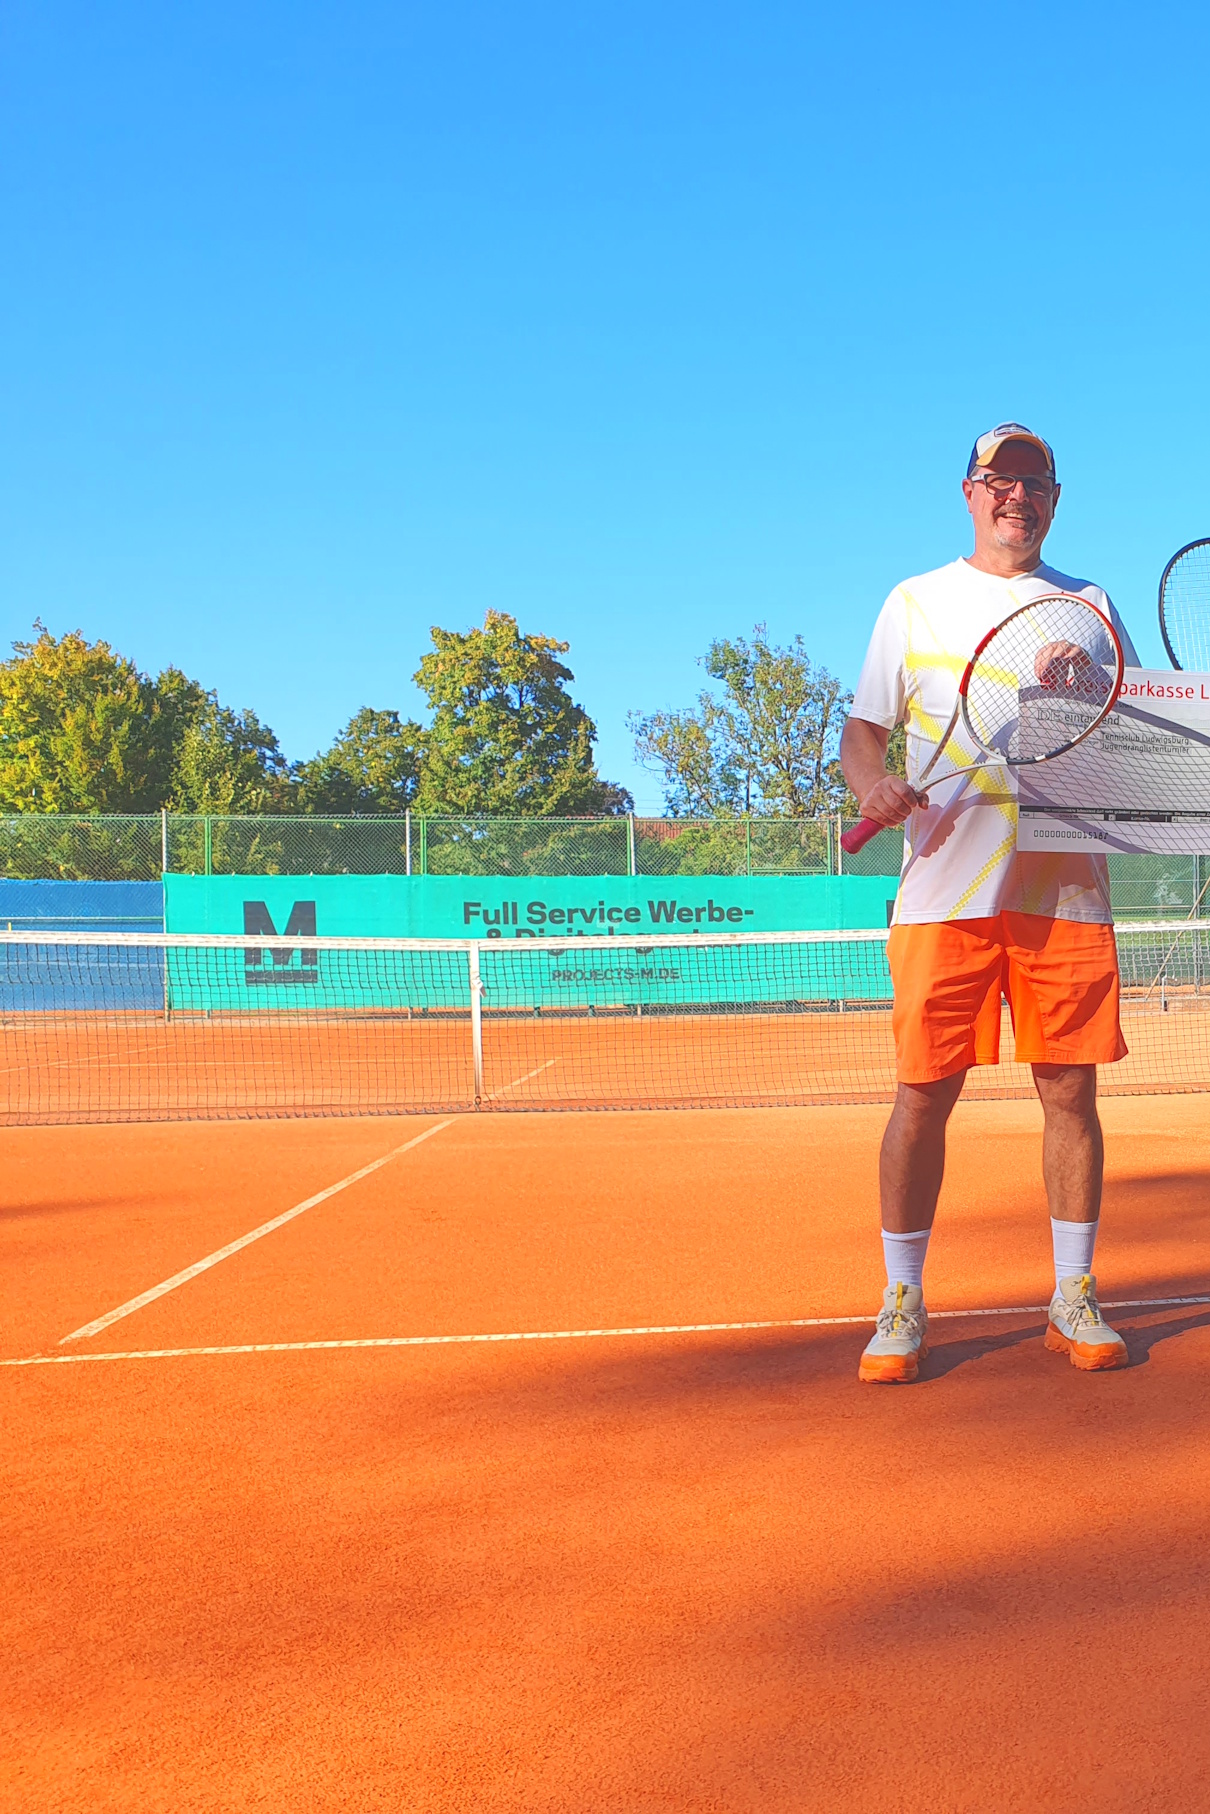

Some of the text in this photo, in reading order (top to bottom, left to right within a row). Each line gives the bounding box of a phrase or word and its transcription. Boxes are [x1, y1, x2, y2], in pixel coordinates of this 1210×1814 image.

[1065, 675, 1195, 699] Kreisparkasse
[463, 899, 755, 925] Full Service Werbe-
[551, 967, 681, 982] PROJECTS-M.DE
